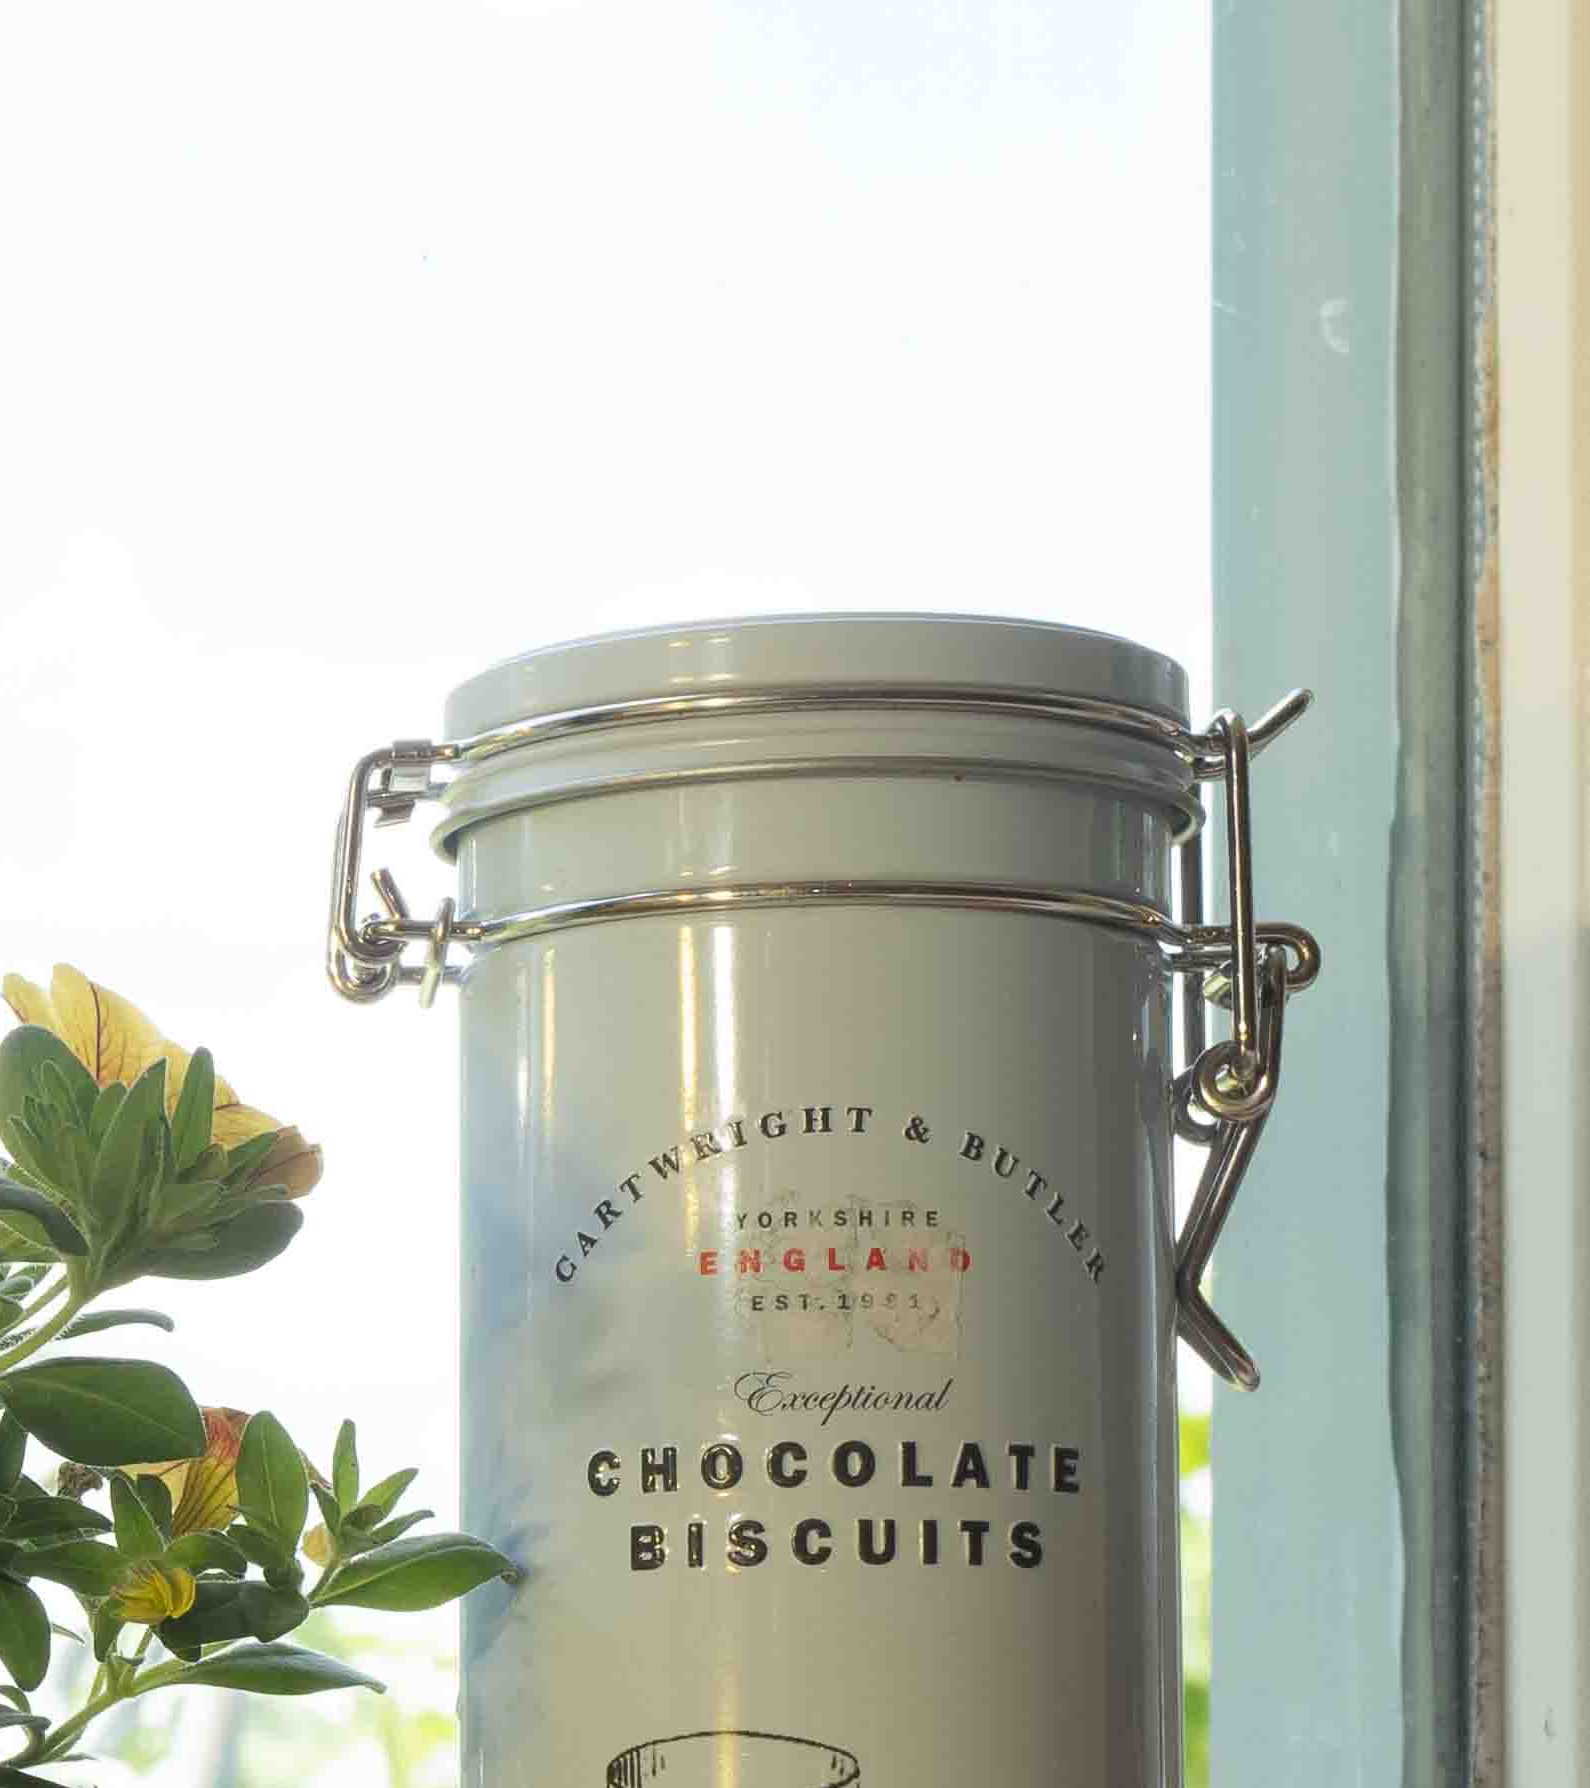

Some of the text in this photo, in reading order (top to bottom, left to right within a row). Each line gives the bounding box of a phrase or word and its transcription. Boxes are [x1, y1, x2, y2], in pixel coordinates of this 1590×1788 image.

[556, 1106, 1106, 1285] CARTWRIGHT & BUTLER
[736, 1210, 939, 1229] YORKSHIRE
[700, 1247, 971, 1275] ENGLAND
[734, 1370, 952, 1427] Exceptional
[587, 1440, 1080, 1497] CHOCOLATE
[629, 1519, 1043, 1572] BISCUITS
